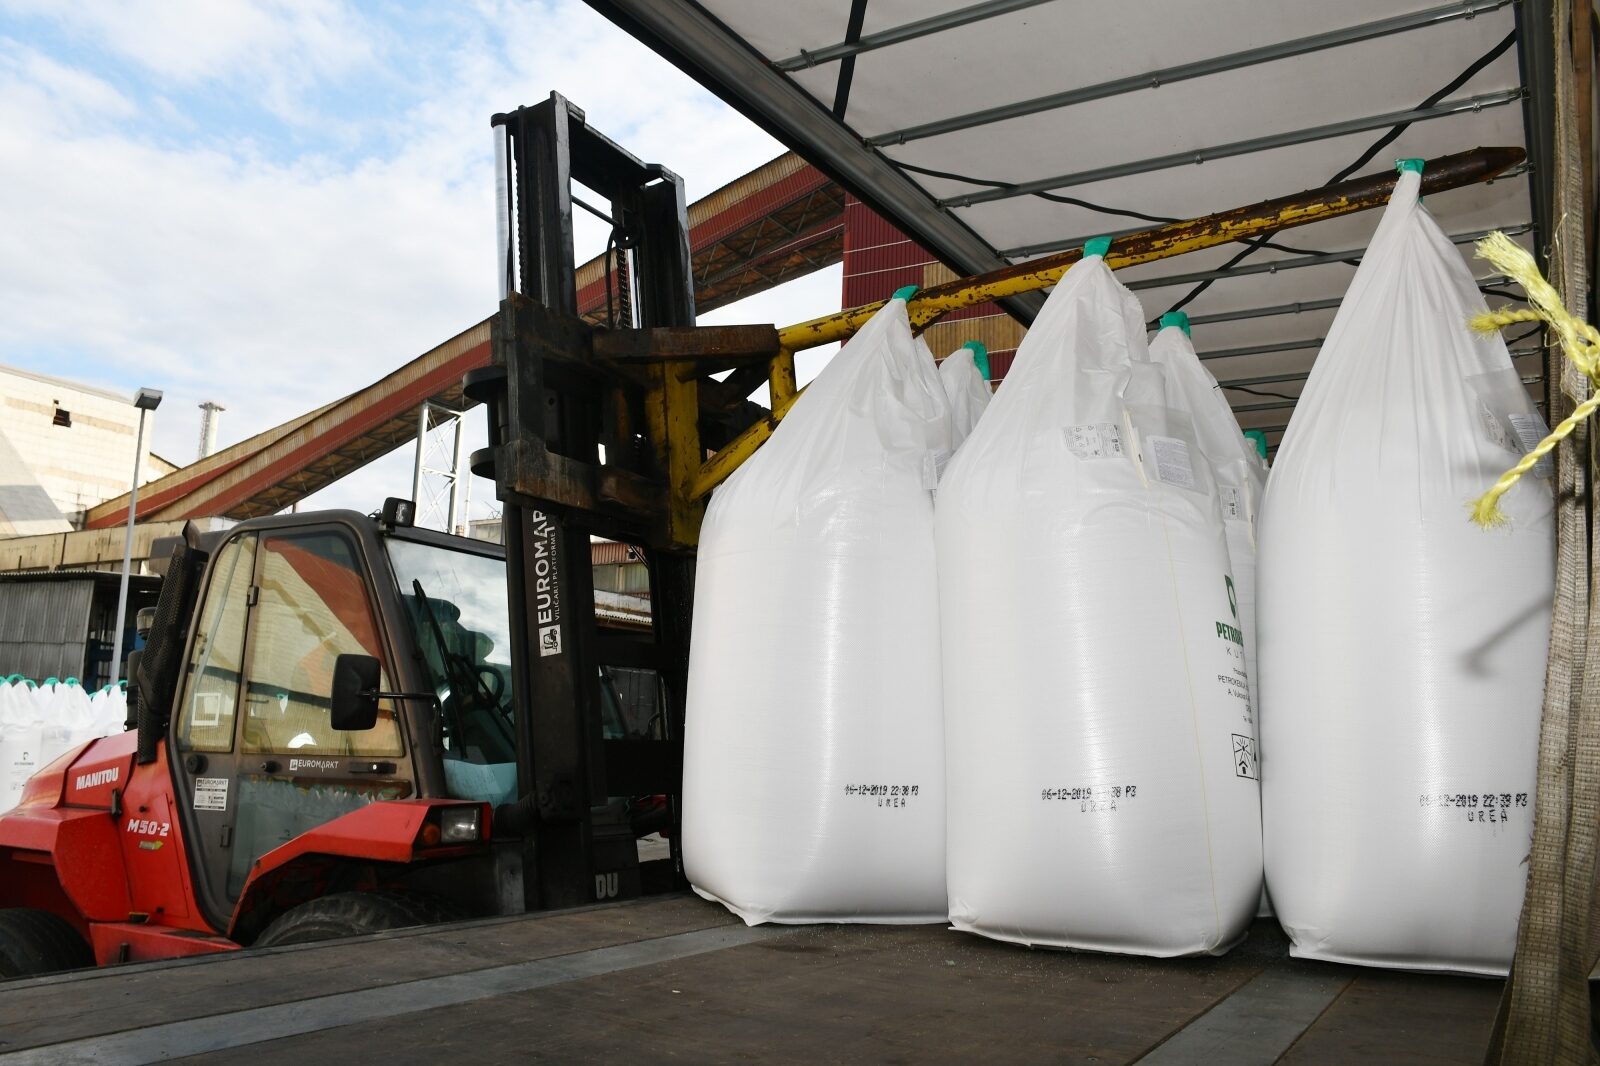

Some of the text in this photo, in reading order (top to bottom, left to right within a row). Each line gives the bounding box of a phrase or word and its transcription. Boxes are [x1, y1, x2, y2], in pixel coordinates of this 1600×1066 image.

[298, 760, 339, 772] EUROMARKT
[76, 767, 119, 790] MANITOU
[1041, 787, 1092, 800] 06-12-2019
[1125, 785, 1137, 798] P3
[1515, 792, 1528, 807] P3
[877, 797, 906, 808] UREA
[1467, 808, 1508, 822] UREA
[595, 872, 618, 900] DU
